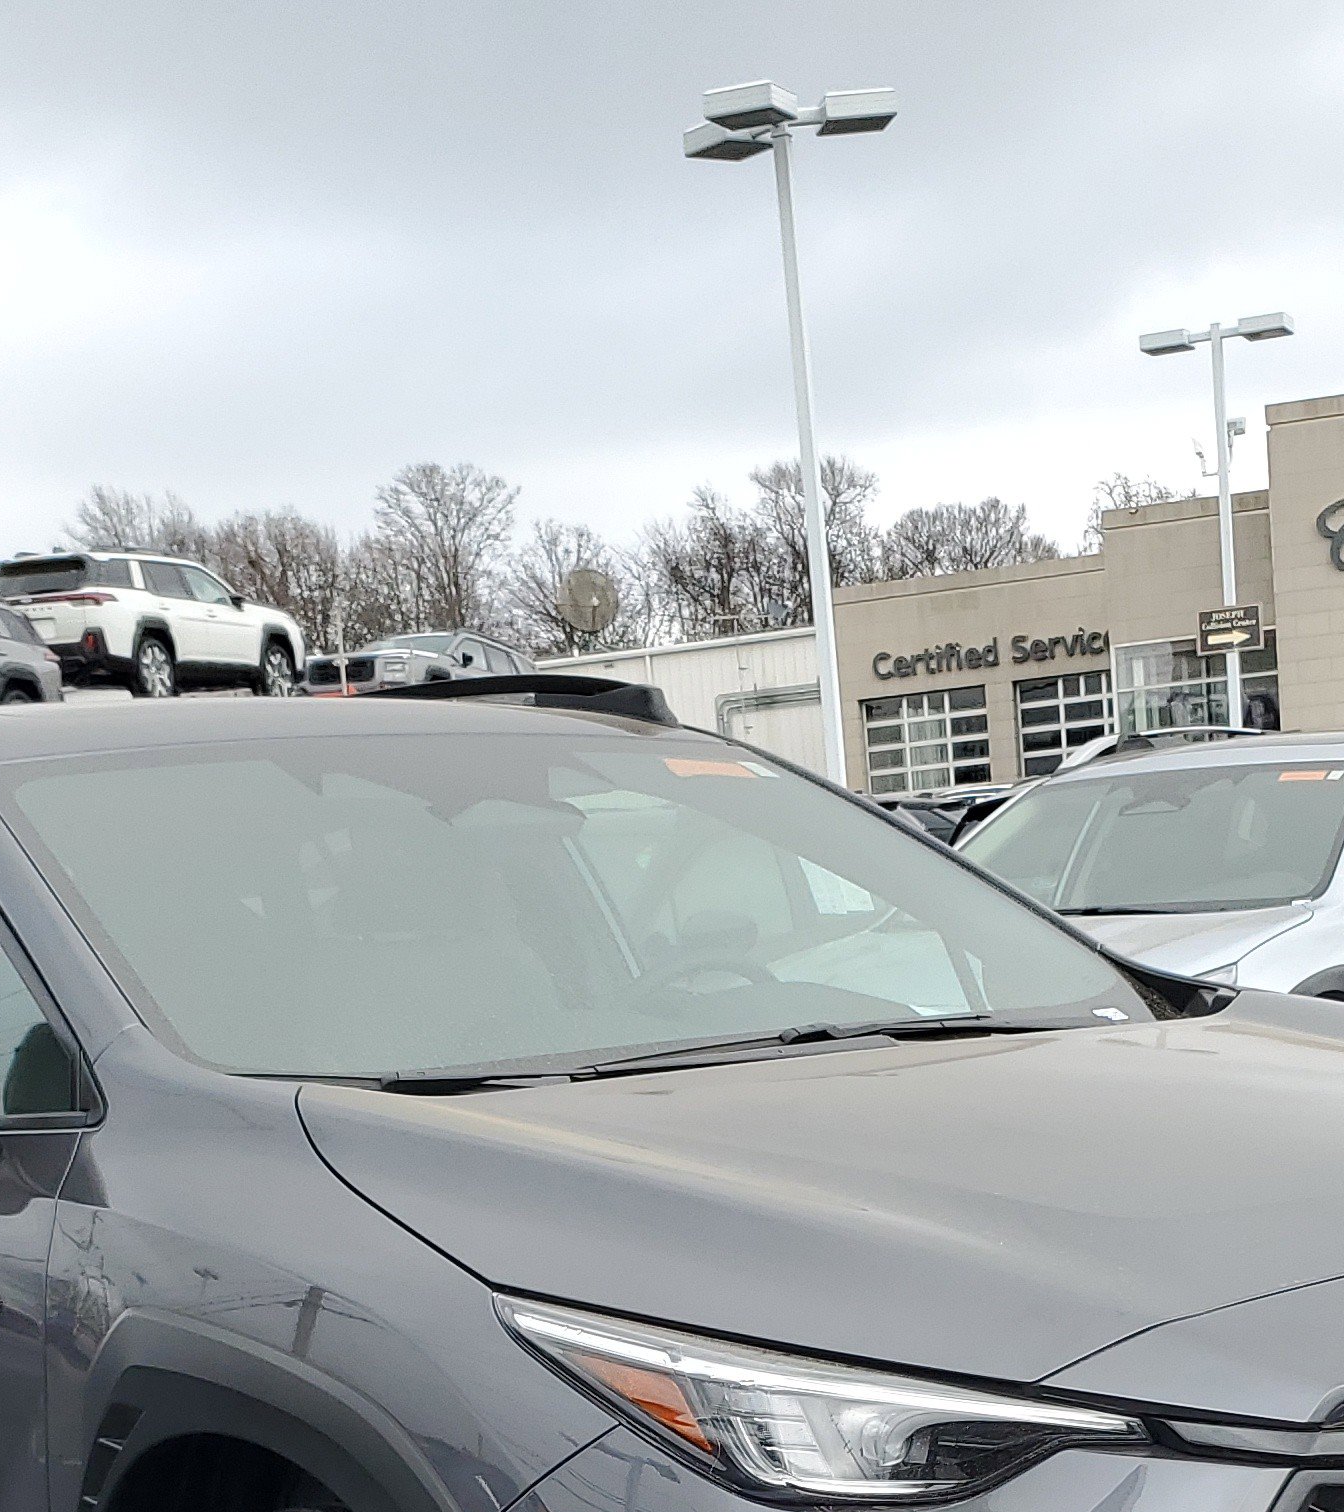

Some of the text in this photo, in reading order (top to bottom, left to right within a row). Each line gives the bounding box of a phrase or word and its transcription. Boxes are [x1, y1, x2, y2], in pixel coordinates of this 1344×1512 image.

[1210, 609, 1246, 621] JOSEPH
[872, 627, 1110, 681] Certified Servic
